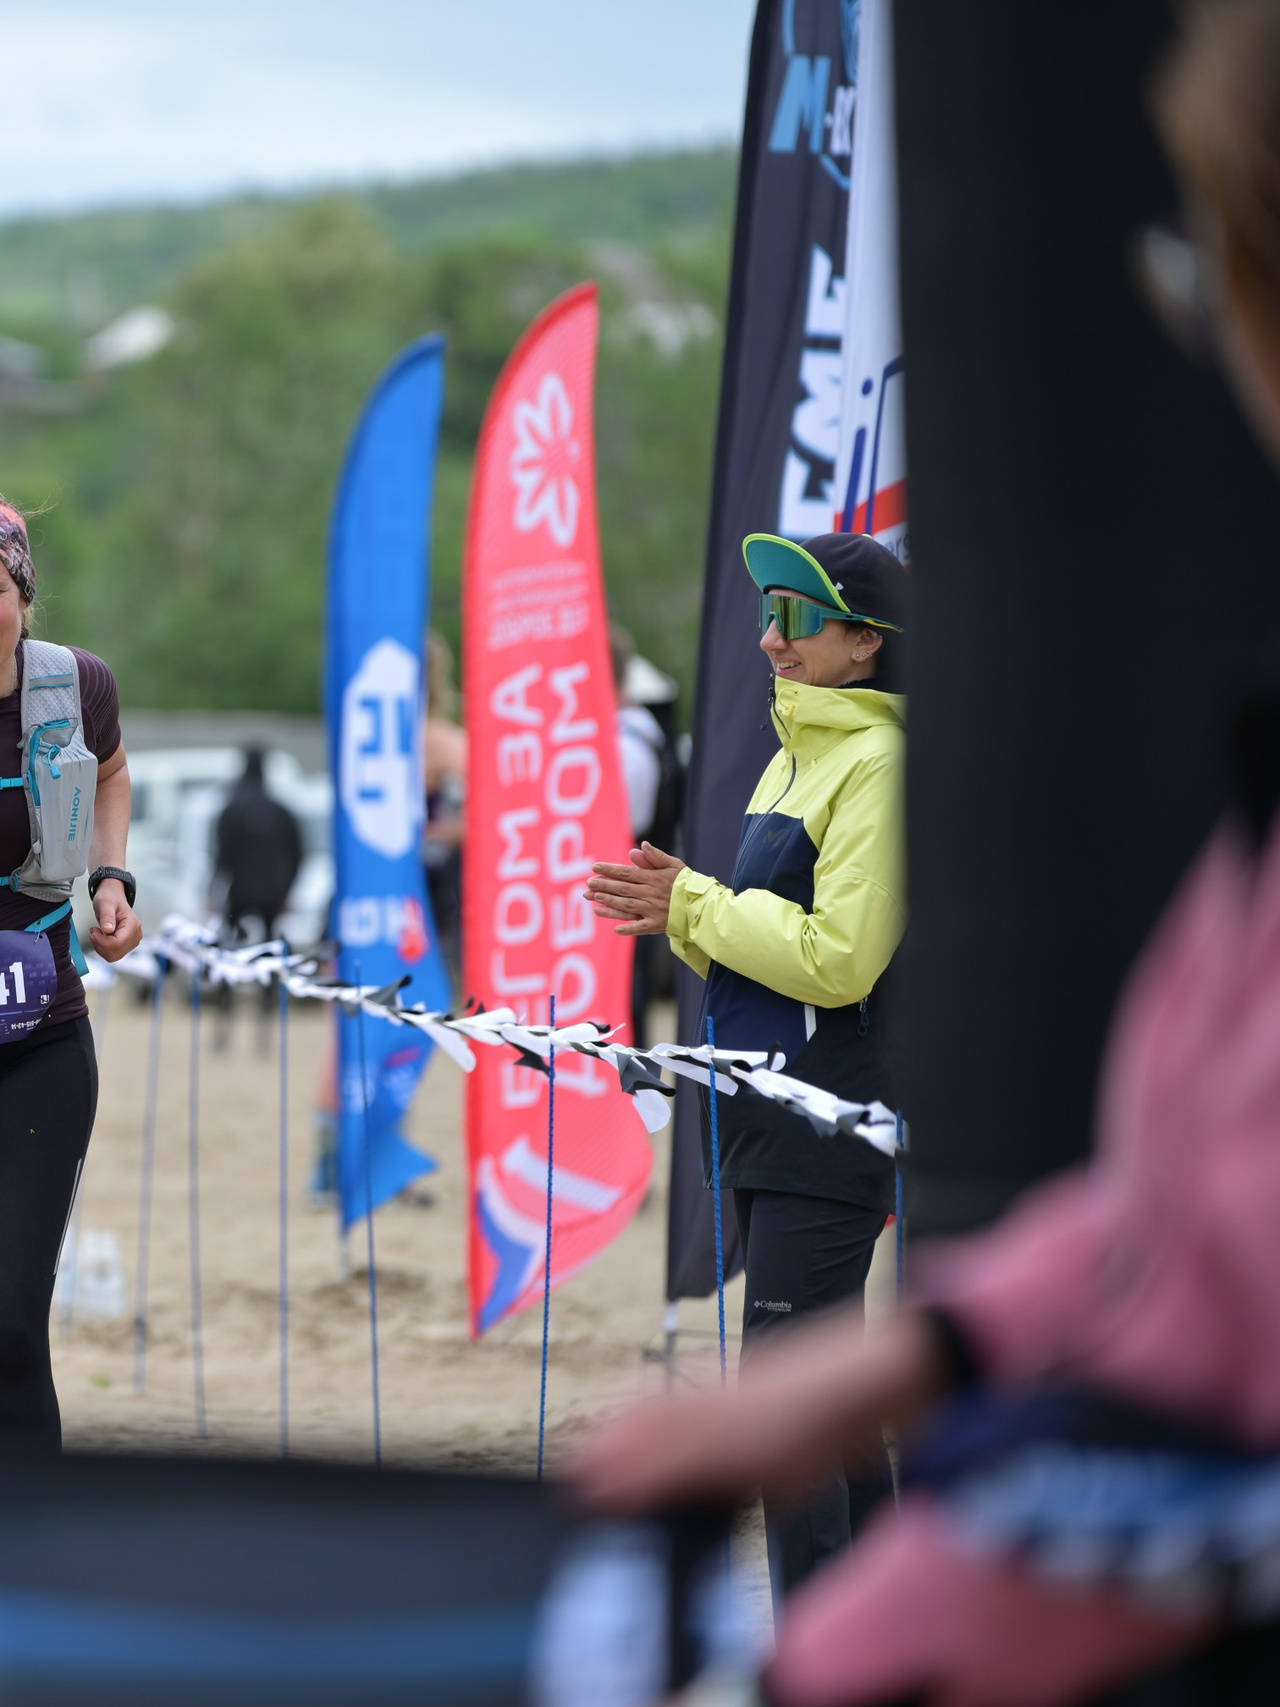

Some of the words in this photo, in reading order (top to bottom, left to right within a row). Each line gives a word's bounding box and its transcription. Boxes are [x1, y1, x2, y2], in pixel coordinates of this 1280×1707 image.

[491, 661, 543, 787] ЗА
[68, 786, 81, 841] AONIJIE
[760, 1300, 792, 1309] Columbia
